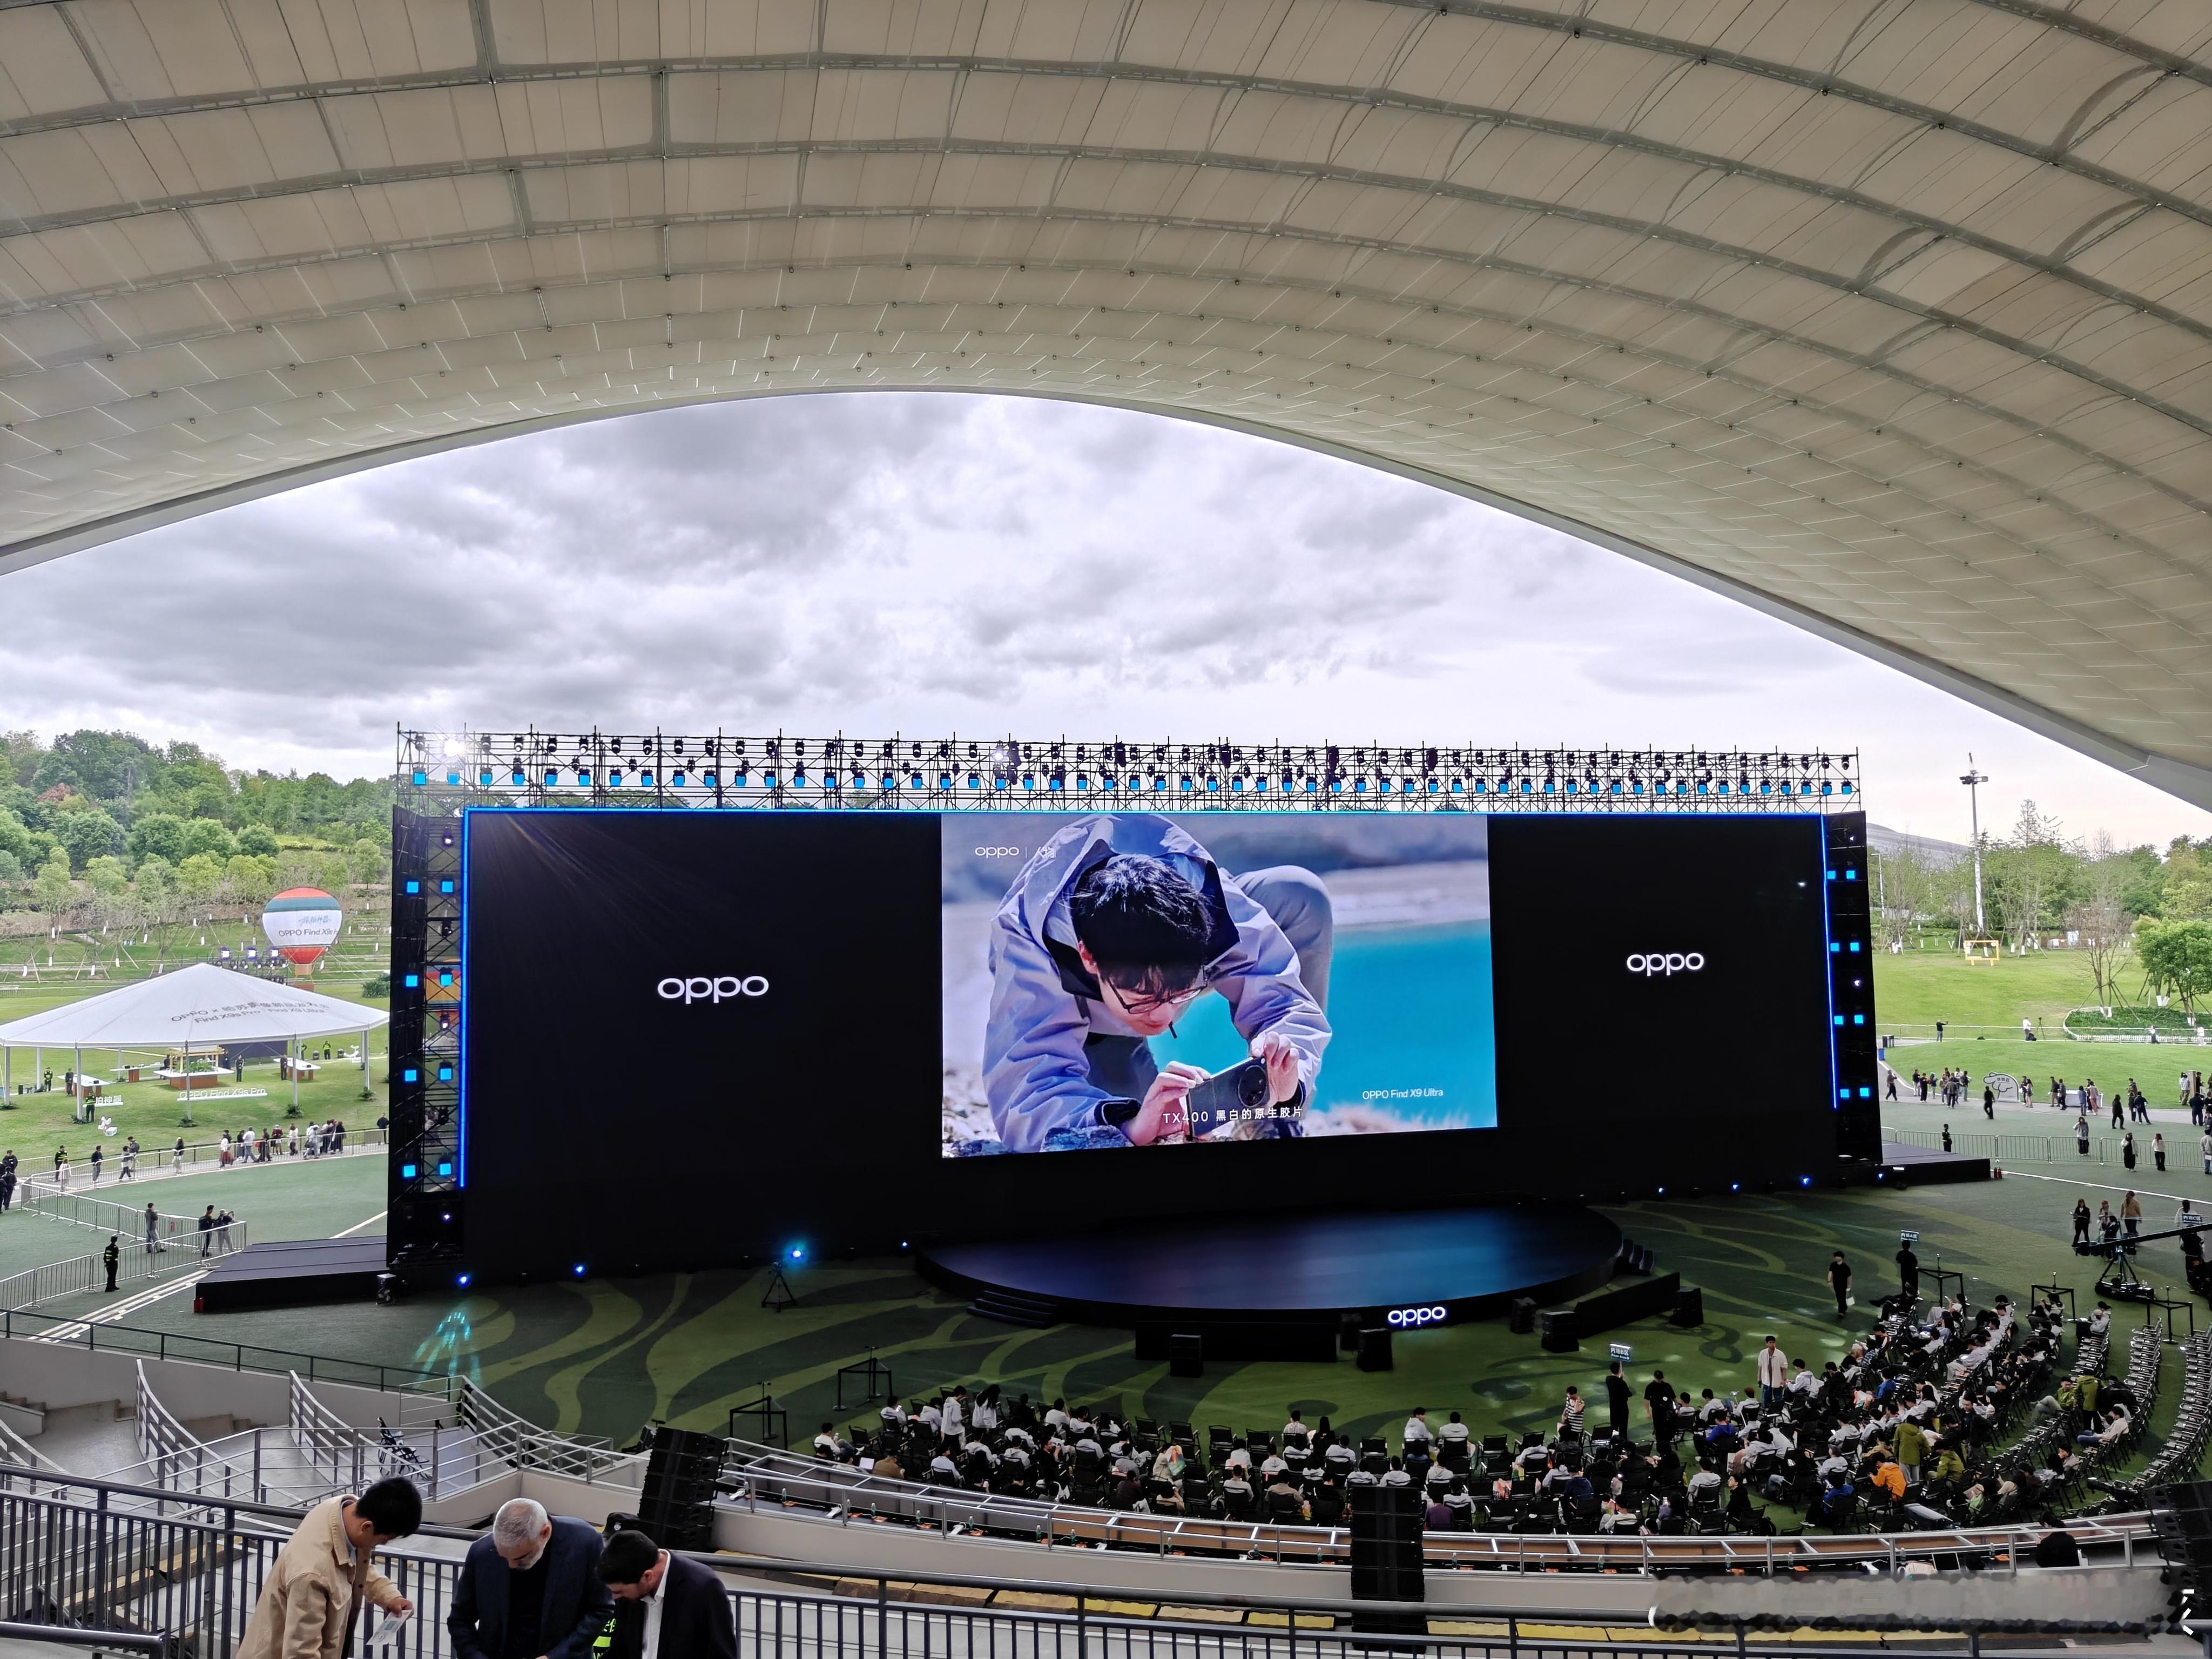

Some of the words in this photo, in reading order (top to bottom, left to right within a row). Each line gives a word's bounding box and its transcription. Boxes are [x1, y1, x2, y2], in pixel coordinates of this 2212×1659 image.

[975, 846, 1020, 859] oppo
[279, 929, 302, 937] OPPO
[1627, 953, 1704, 976] oppo
[657, 975, 769, 1004] oppo
[171, 1010, 208, 1022] OPPO
[194, 1015, 219, 1023] Find
[179, 1090, 208, 1099] OPPO
[1363, 1090, 1388, 1100] OPPO
[1391, 1089, 1408, 1098] Find
[1410, 1088, 1422, 1097] X9
[1424, 1088, 1444, 1097] Ultra
[1163, 1111, 1209, 1124] TX400
[1216, 1106, 1303, 1121] 黑白的原生胶片
[1387, 1306, 1446, 1326] oppo
